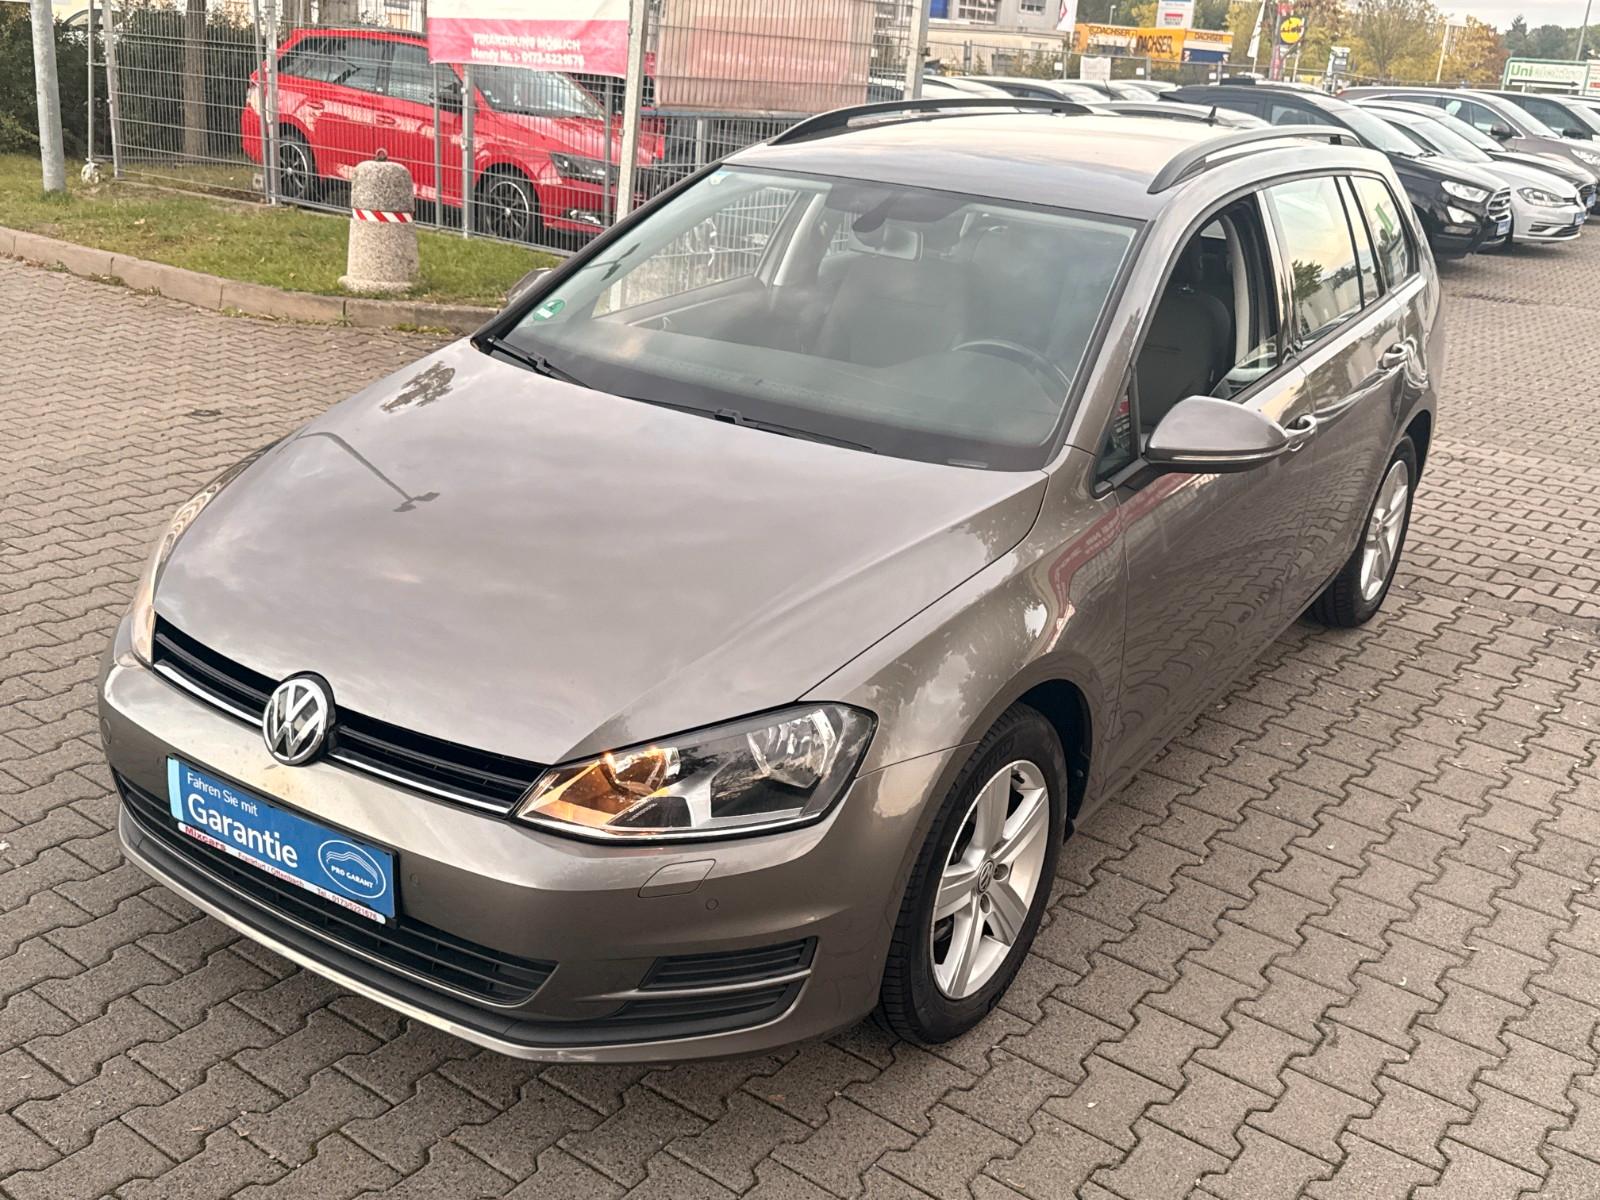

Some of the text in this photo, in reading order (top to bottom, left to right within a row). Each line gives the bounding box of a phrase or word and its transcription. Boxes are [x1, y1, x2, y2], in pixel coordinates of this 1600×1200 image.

[187, 772, 258, 816] Fahren Sie mit
[188, 793, 299, 868] Garantie
[330, 865, 374, 889] PRO GARANT
